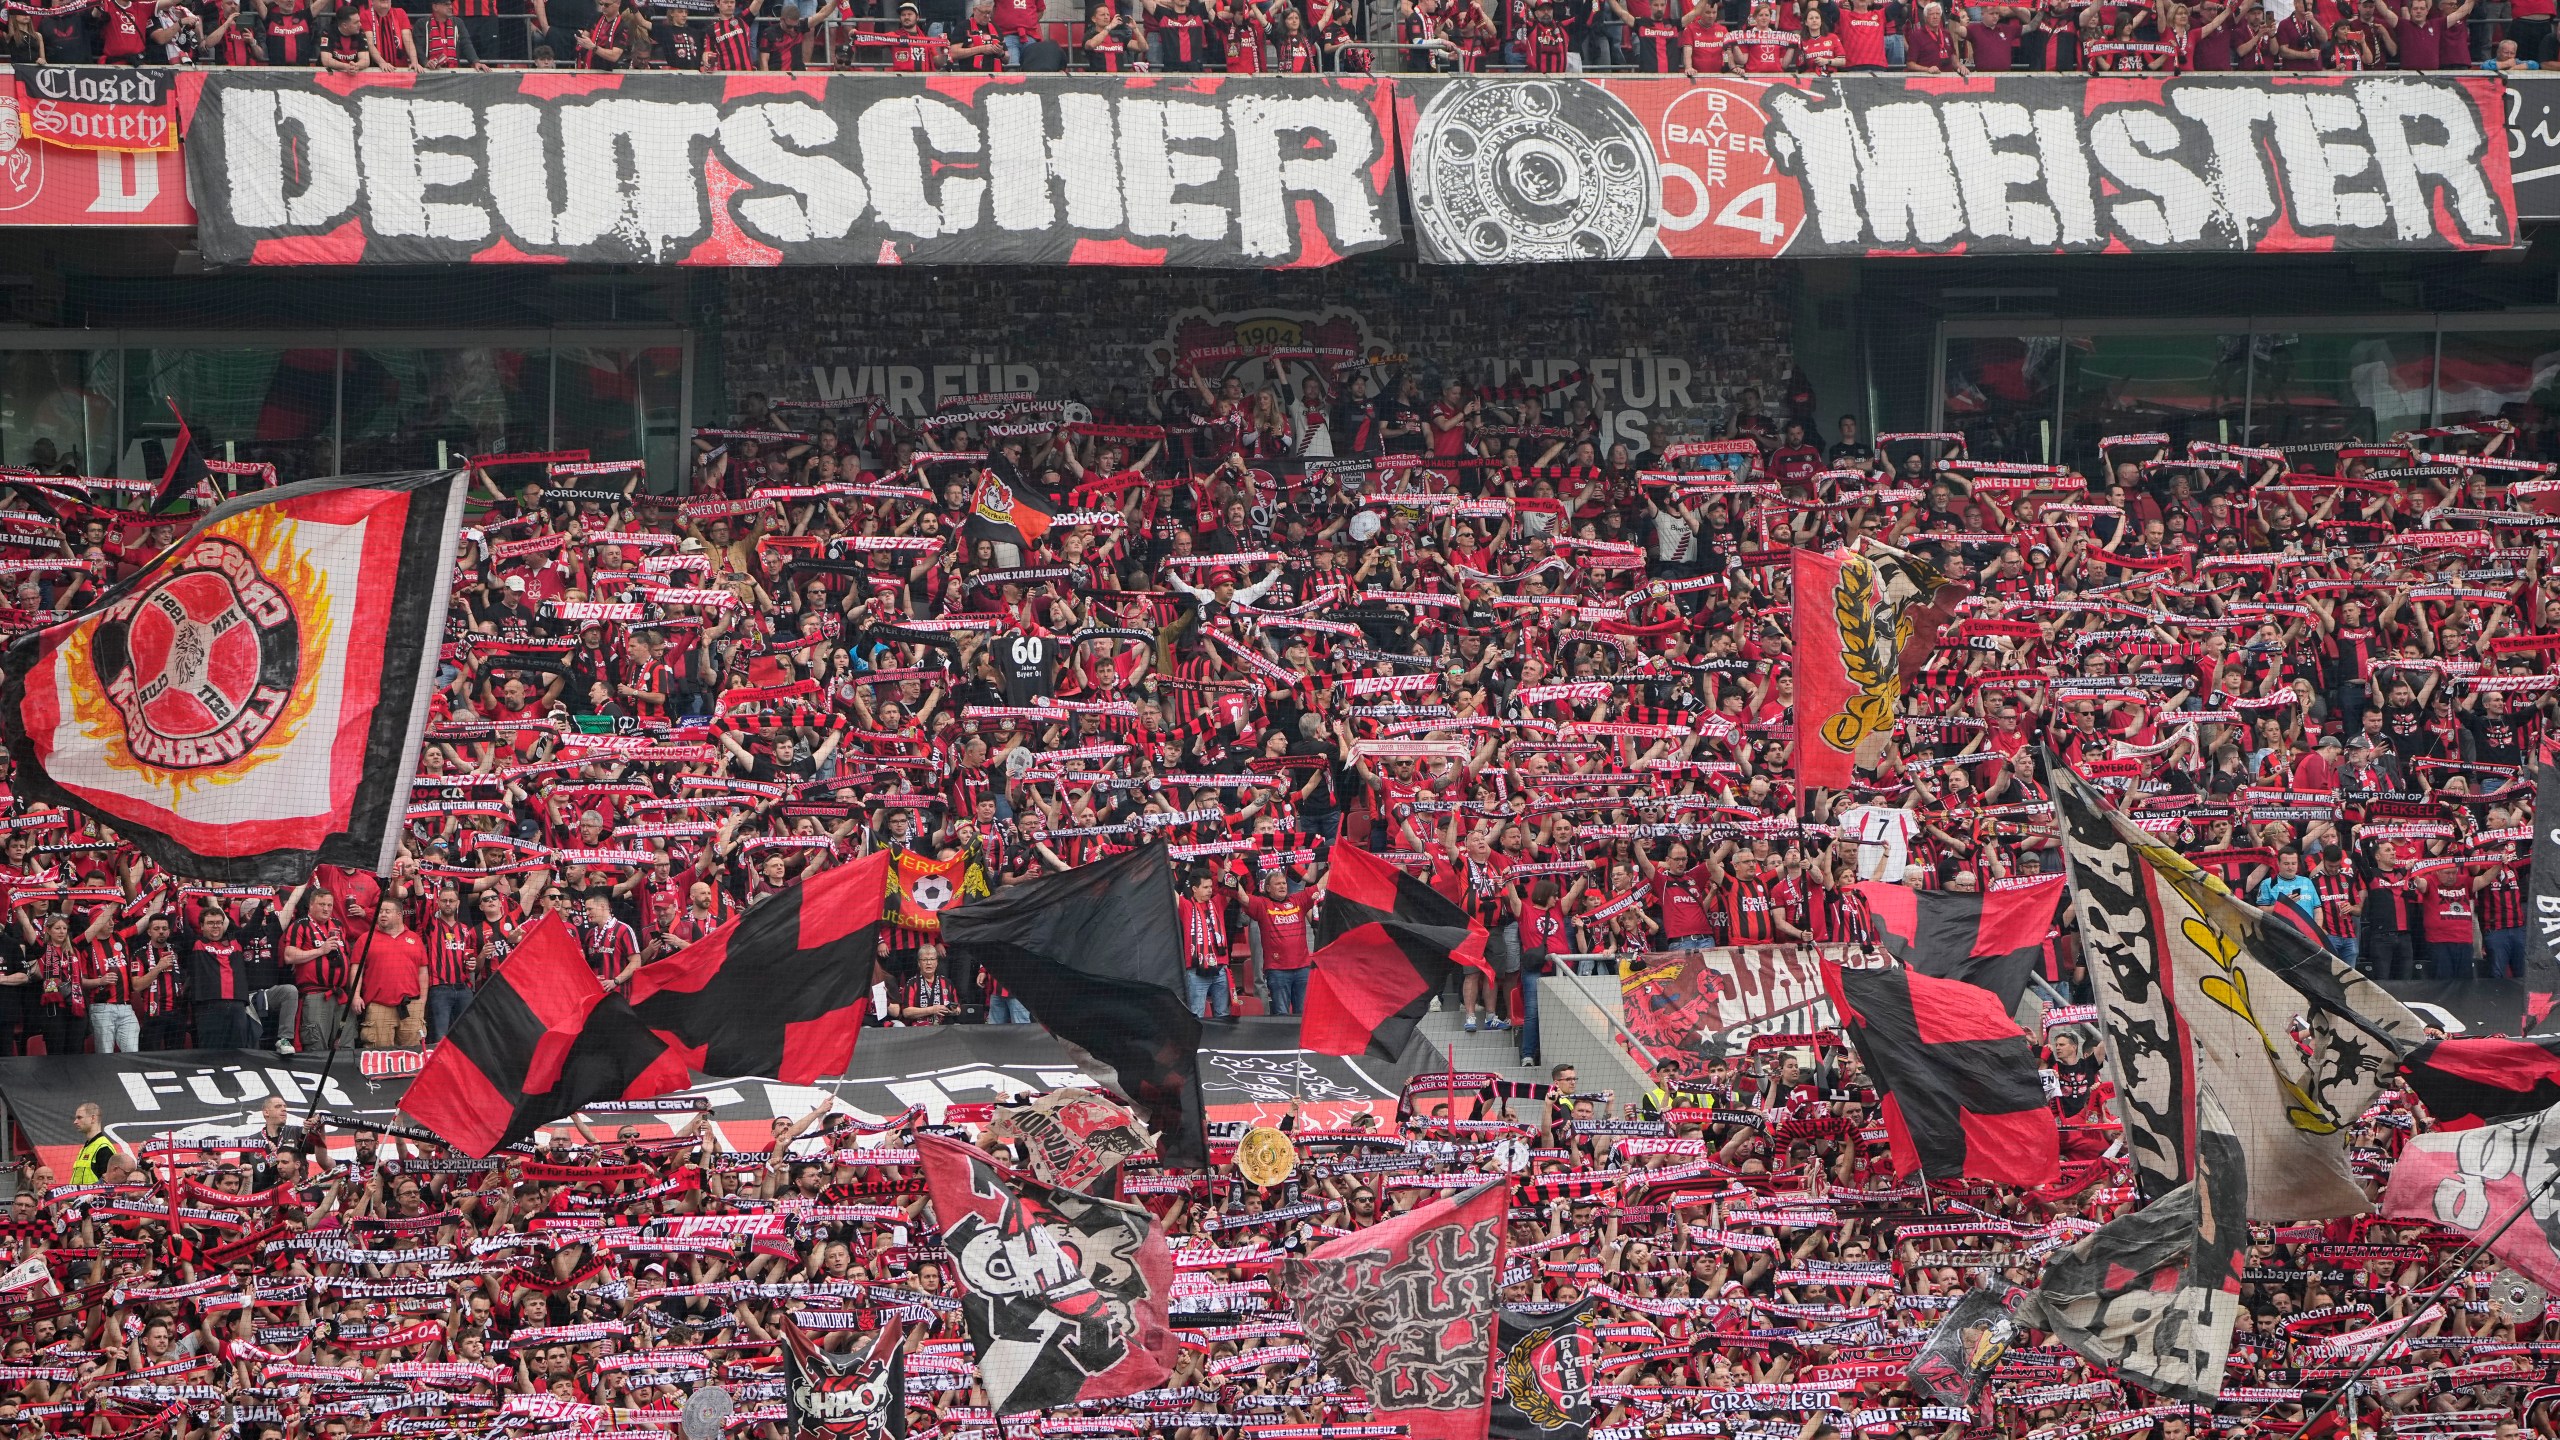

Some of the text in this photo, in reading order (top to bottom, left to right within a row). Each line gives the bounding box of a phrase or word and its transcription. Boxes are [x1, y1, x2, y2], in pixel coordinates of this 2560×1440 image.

[35, 68, 157, 103] Closed
[33, 100, 167, 147] Society
[1668, 124, 1768, 156] BAYER
[1707, 94, 1728, 188] BAYER
[1772, 80, 2502, 247] MEISTER
[221, 86, 1389, 258] DEUTSCHER
[1660, 163, 1784, 245] 04
[1242, 327, 1297, 346] 1904
[812, 365, 926, 416] WIR
[933, 354, 1041, 414] FÜR
[1590, 348, 1693, 408] FÜR
[1690, 441, 1754, 455] LEVERKUSEN
[1377, 460, 1421, 468] OFFENBACH
[2439, 453, 2539, 469] BAYER 04 LEVERKUSEN
[2390, 466, 2459, 477] 04 LEVERKUSEN
[1975, 478, 2032, 489] BAYER 04
[545, 489, 620, 500] NORDKURVE
[855, 537, 931, 549] MEISTER
[645, 556, 710, 573] MEISTER
[980, 569, 1069, 583] DANKE XABI ALONSO
[1671, 577, 1717, 590] IN BERLIN
[653, 589, 734, 604] MEISTER
[2410, 589, 2506, 599] GEMEINSAM UNTERM KREUZ
[564, 604, 635, 618] MEISTER
[469, 634, 484, 642] DIE
[486, 636, 524, 644] MACHT
[527, 637, 544, 645] AM
[1012, 637, 1042, 663] 60
[1354, 675, 1435, 695] MEISTER
[2478, 677, 2554, 691] MEISTER
[1530, 684, 1611, 702] MEISTER
[2232, 688, 2297, 706] MEISTER
[1580, 725, 1659, 735] LEVERKUSEN
[563, 736, 645, 747] MEISTER
[558, 784, 587, 792] Bayer
[605, 783, 652, 793] Leverkusen
[682, 777, 782, 794] GEMEINSAM UNTERM KREUZ
[2246, 790, 2283, 800] EMEINSAM
[2285, 792, 2311, 801] UNTERM
[2147, 809, 2169, 817] Bayer
[2183, 808, 2227, 817] Leverkusen
[2370, 804, 2442, 815] WERKSELF
[12, 814, 44, 827] UNTERM
[1877, 819, 1889, 841] 7
[2360, 823, 2454, 837] BAYER 04 LEVERKUSEN
[520, 857, 544, 867] KREUZ
[1674, 895, 1697, 903] RWE
[2438, 888, 2466, 897] MEISTER
[118, 1066, 353, 1110] FÜR
[586, 1099, 694, 1110] NORTH SIDE CREW
[146, 1139, 268, 1151] GEMENSAM UNTERM KREUZ
[1299, 1134, 1404, 1146] BAYER 04 LEVERKUSEN
[1628, 1139, 1703, 1155] MEISTER
[526, 1167, 637, 1176] Wir für Euch Ihr für
[194, 1187, 231, 1202] STEHEN
[250, 1191, 270, 1202] DIR!
[113, 1200, 239, 1223] GEMEINSAM KREUZ
[835, 1205, 899, 1217] LEVERKUSEN
[1730, 1211, 1775, 1221] BAYER 04
[682, 1216, 774, 1237] MEISTER
[604, 1235, 730, 1250] BAYER 04 LEVERKUSEN
[1176, 1244, 1258, 1264] MEISTER
[2313, 1246, 2424, 1259] LEVERKUSEN
[798, 1312, 854, 1328] NORDKURVE
[2278, 1305, 2353, 1336] DIE MACHT AM
[1596, 1328, 1629, 1337] UNTERM
[167, 1358, 197, 1372] KREUZ
[1542, 1356, 1592, 1375] BAYER
[1560, 1340, 1577, 1390] BAYER
[1818, 1365, 1906, 1380] BAYER 04
[1560, 1395, 1590, 1406] 04
[1923, 1407, 1970, 1423] HERS
[1322, 1427, 1362, 1436] UNTERM
[1365, 1425, 1397, 1436] KREUZ
[1594, 1422, 1720, 1440] BROT HERS
